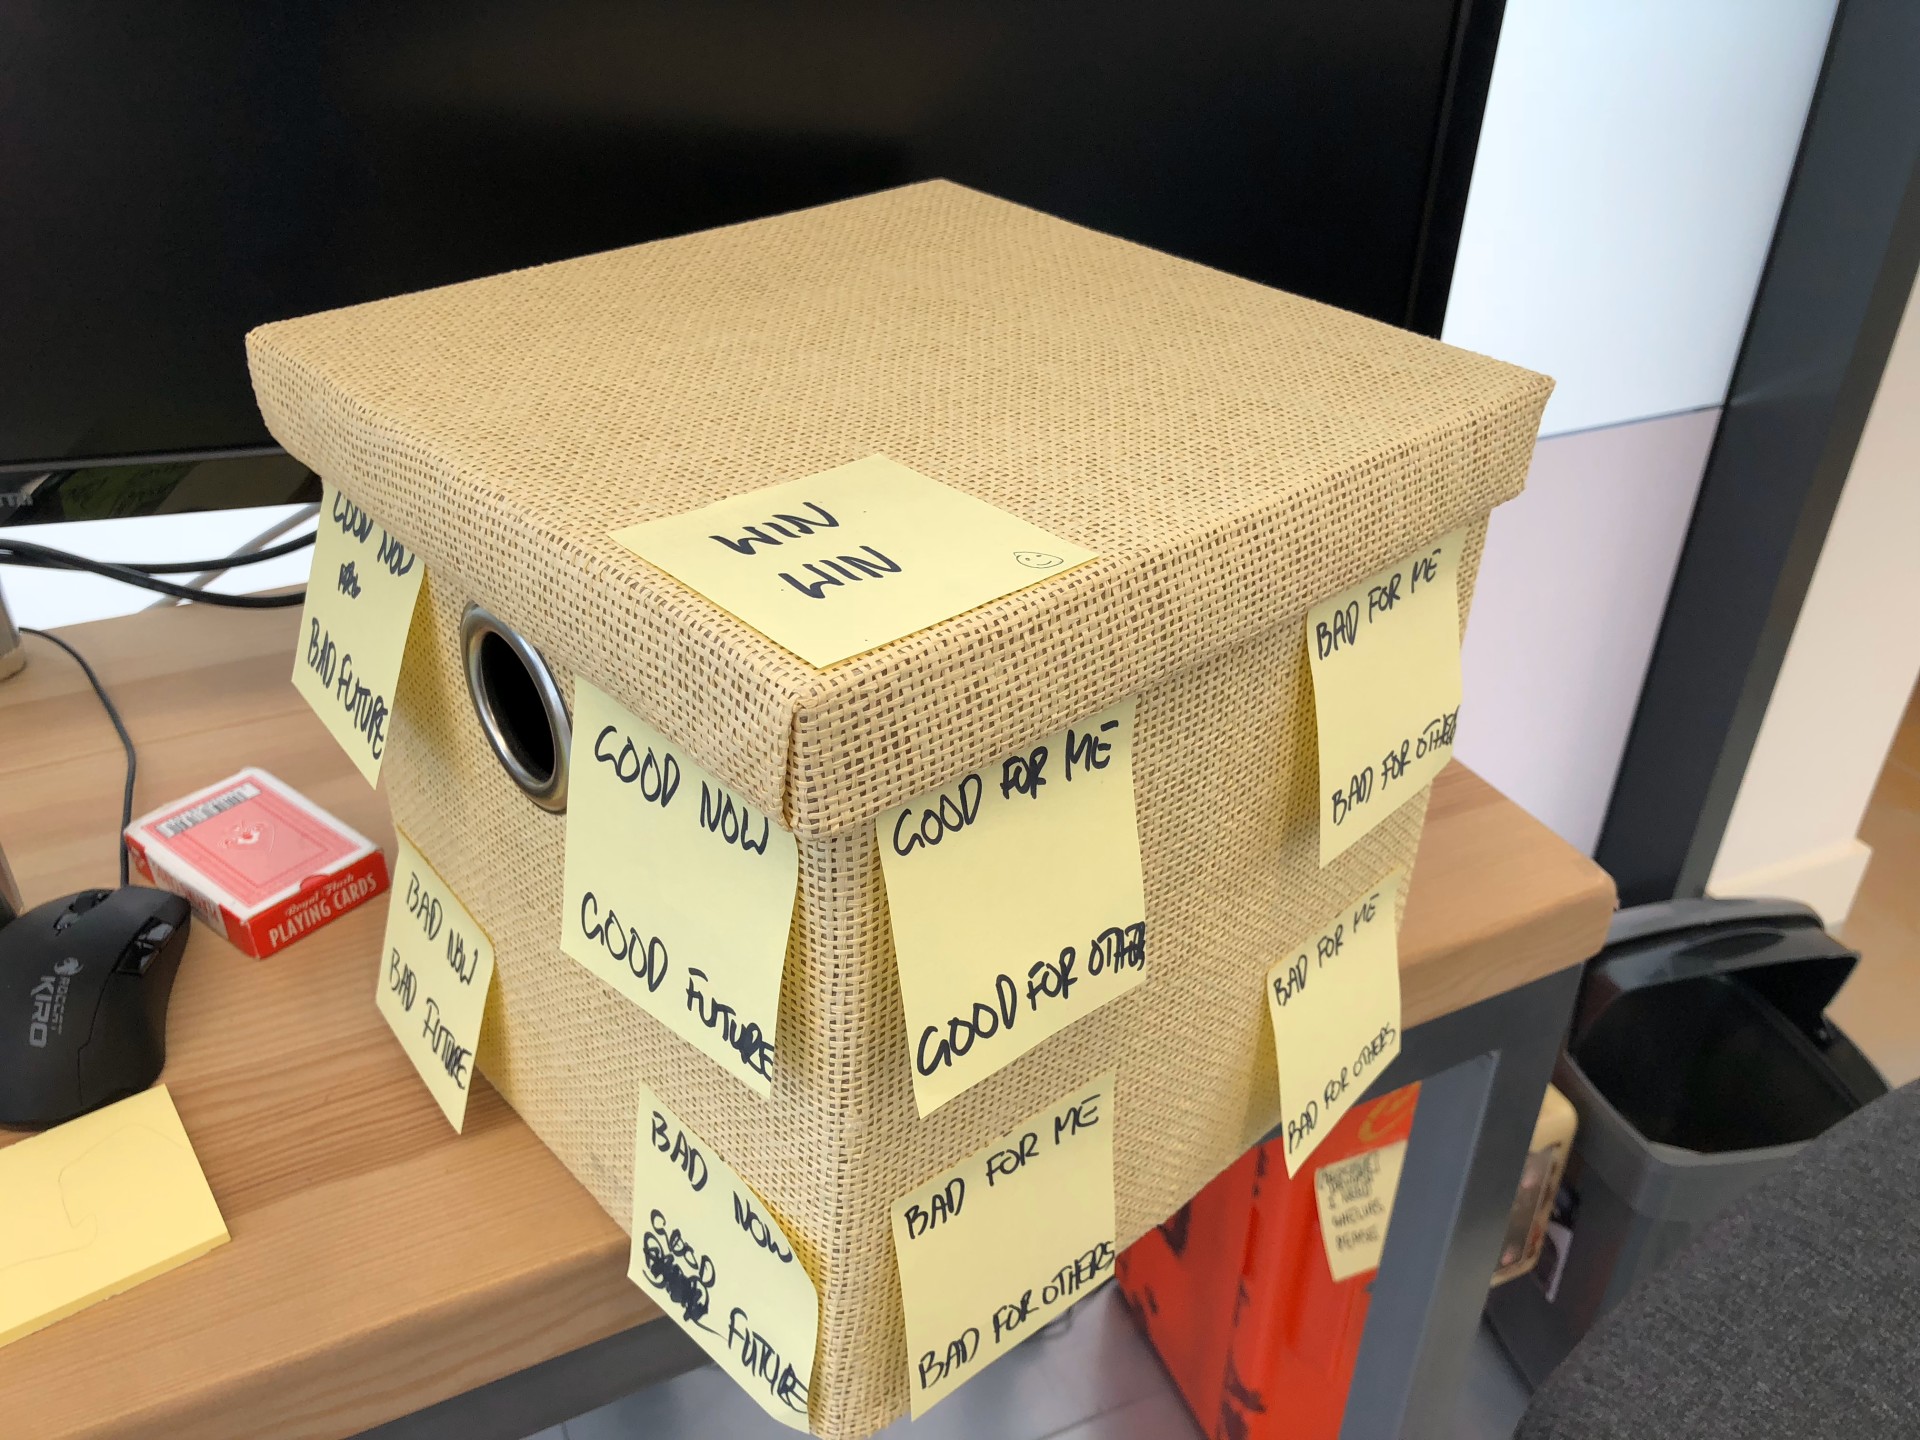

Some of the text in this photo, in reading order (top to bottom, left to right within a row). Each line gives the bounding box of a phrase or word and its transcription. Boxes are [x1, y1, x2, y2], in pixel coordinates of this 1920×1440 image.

[709, 502, 840, 556] WIN
[778, 546, 903, 599] WIN
[1315, 548, 1442, 661] BAD FOR ME
[307, 616, 389, 760] BAD FUTURE
[594, 725, 770, 856] GOOD NOW
[892, 719, 1120, 857] GOOD FOR ME
[1331, 766, 1373, 826] BAD
[1381, 739, 1411, 791] FOR
[268, 872, 377, 949] PLAYING CARDS
[406, 872, 479, 986] BAD NOW
[1273, 893, 1380, 1006] BAD FOR ME
[29, 975, 57, 1049] KIRO
[389, 947, 473, 1091] BAD FUTURE
[581, 891, 775, 1083] GOOD FUTURE
[916, 973, 1018, 1077] GOOD
[1026, 946, 1079, 1011] FOR
[1287, 1100, 1319, 1155] BAD
[1323, 1066, 1349, 1111] FOR
[1352, 1022, 1396, 1078] OTHERS
[652, 1110, 794, 1264] BAD NOW
[904, 1094, 1101, 1240] BAD FOR ME
[650, 1209, 716, 1289] GOOD
[728, 1307, 811, 1415] FUTURE
[918, 1240, 1116, 1390] BAD FOR OTHERS
